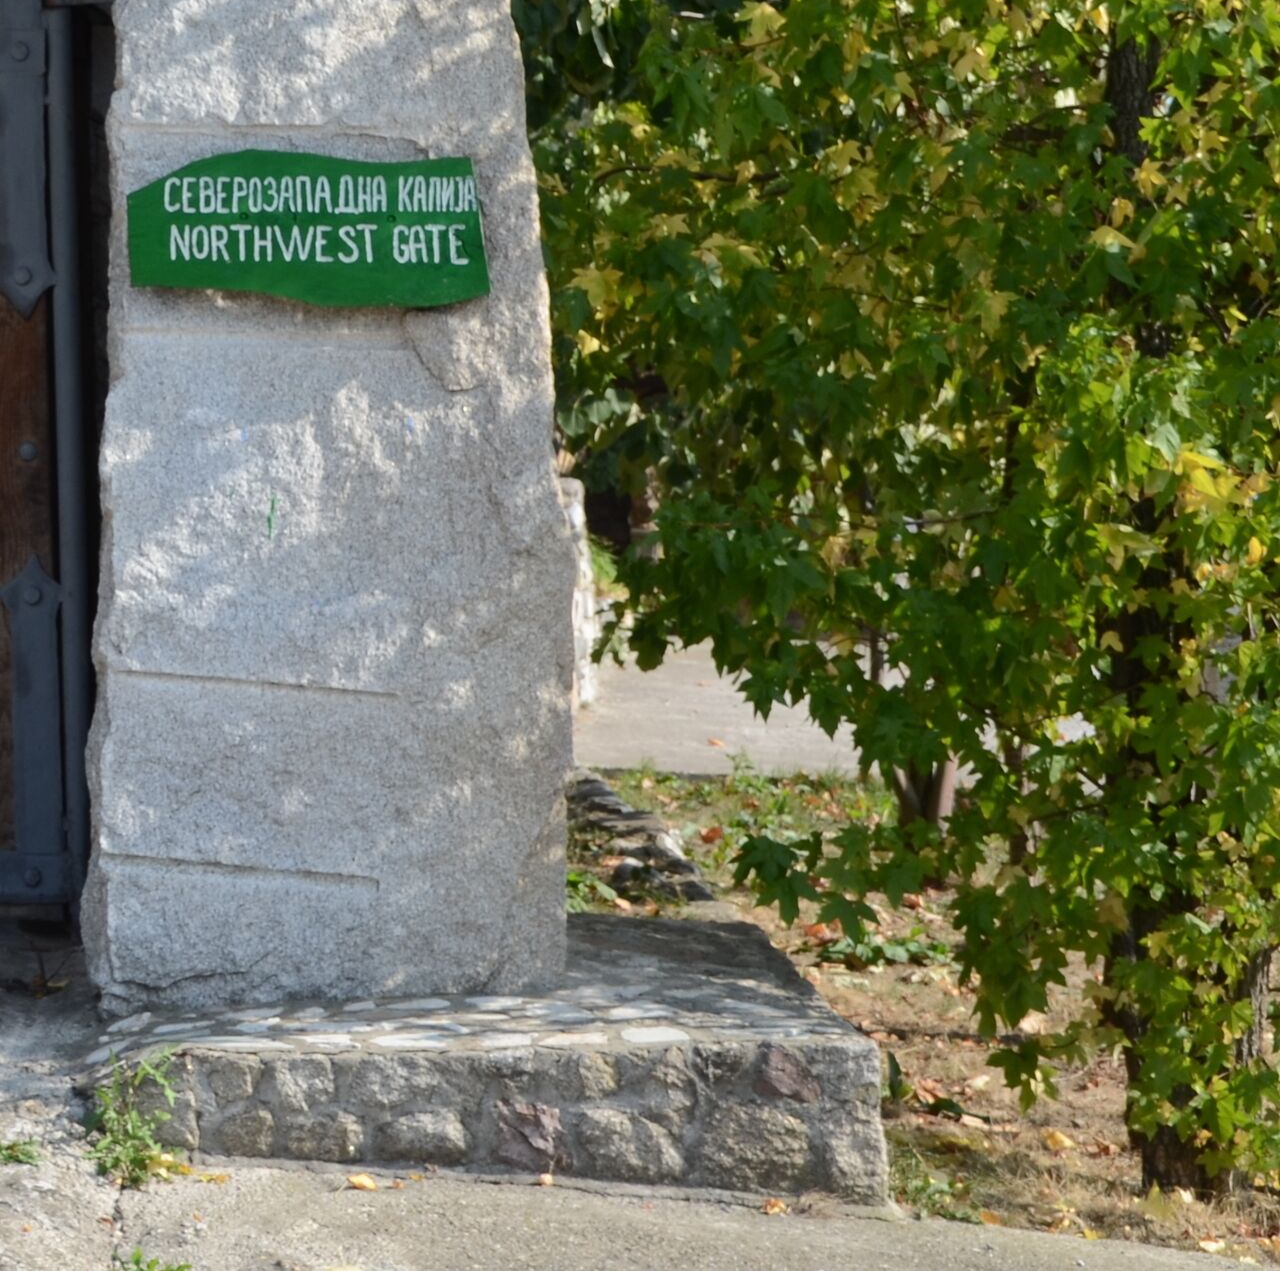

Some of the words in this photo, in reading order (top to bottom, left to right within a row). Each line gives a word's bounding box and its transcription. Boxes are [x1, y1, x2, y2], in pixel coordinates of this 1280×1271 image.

[163, 175, 387, 215] СЕВЕРОЗАПАДНА
[397, 175, 477, 213] КАПИЈА
[169, 224, 378, 263] NORTHWEST
[392, 224, 469, 265] GATE
